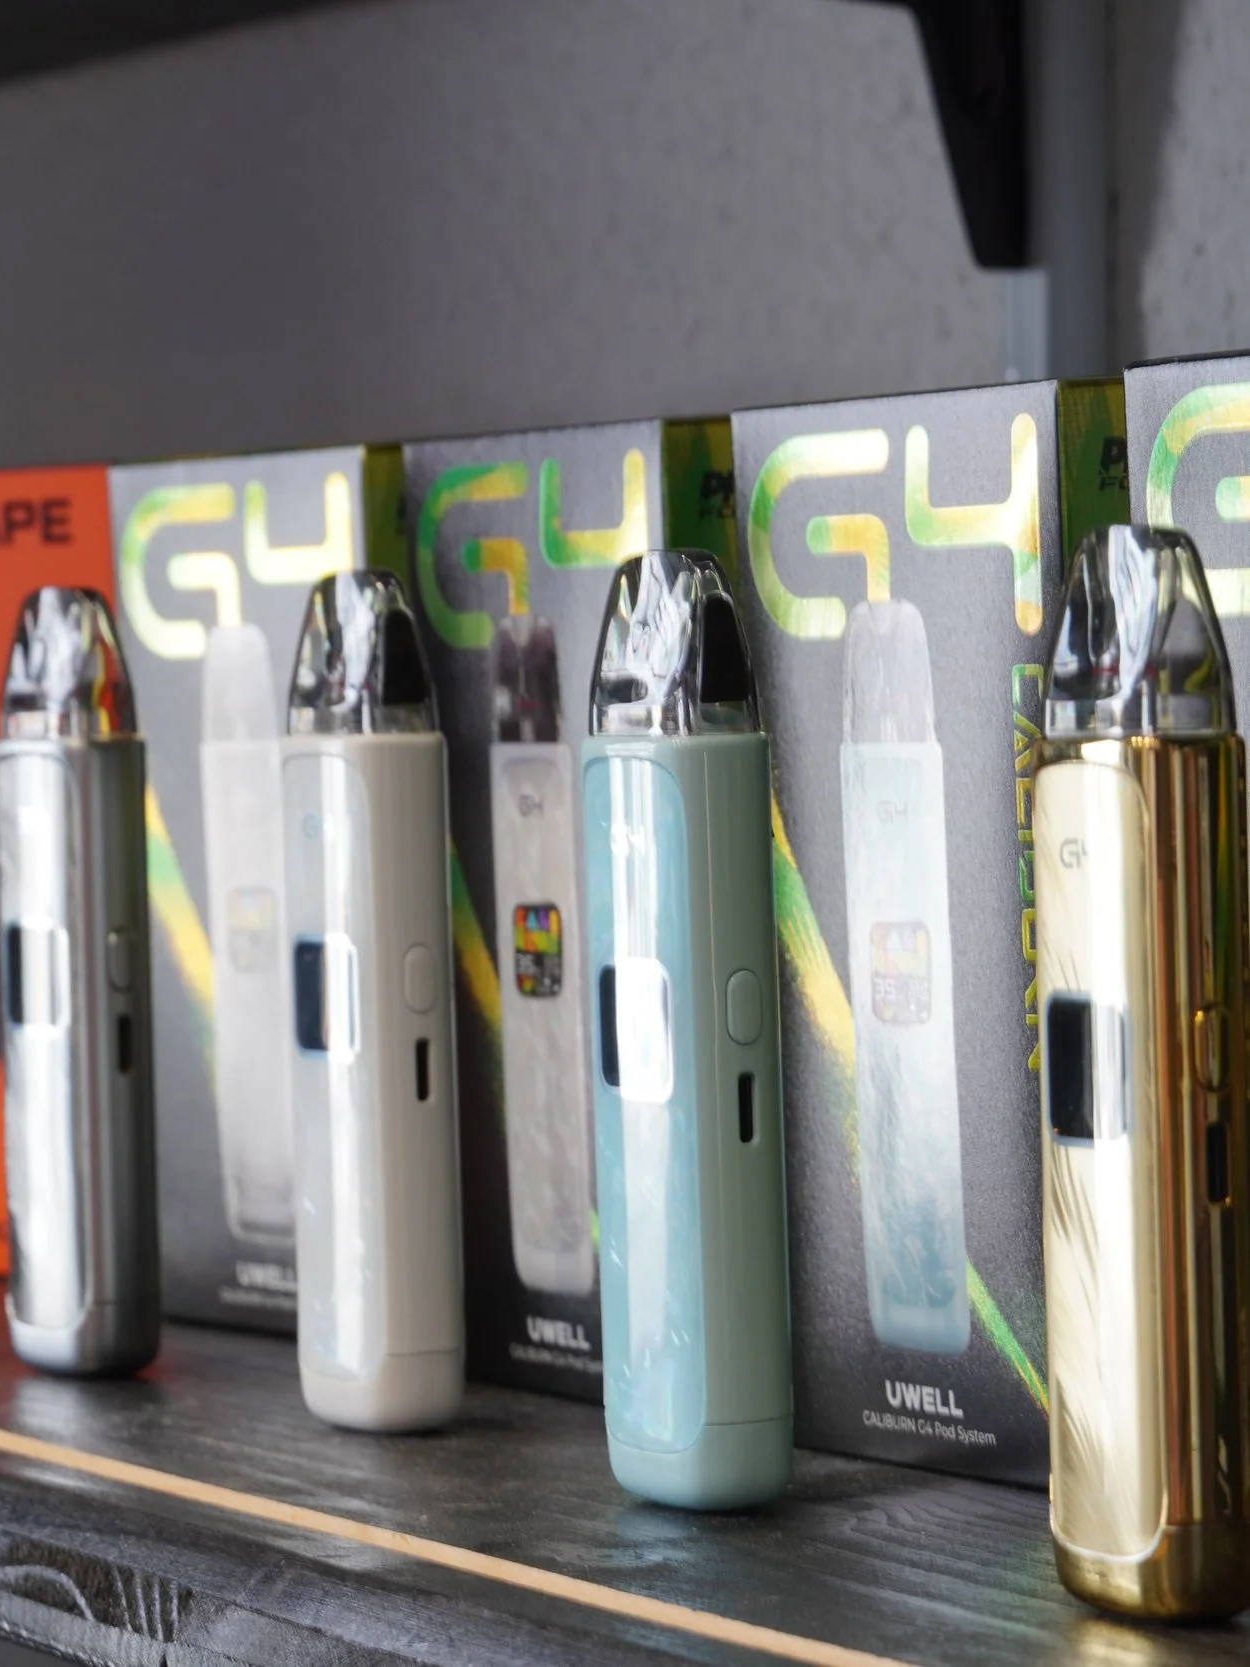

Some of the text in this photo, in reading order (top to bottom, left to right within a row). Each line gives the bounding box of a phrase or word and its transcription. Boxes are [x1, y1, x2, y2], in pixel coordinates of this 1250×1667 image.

[119, 471, 354, 659] G4
[416, 448, 649, 649] G4
[749, 412, 1043, 640] G4
[862, 1409, 917, 1434] CALIBURN
[934, 1421, 957, 1441] Pod
[956, 1425, 997, 1448] System
[884, 1379, 964, 1419] UWELL
